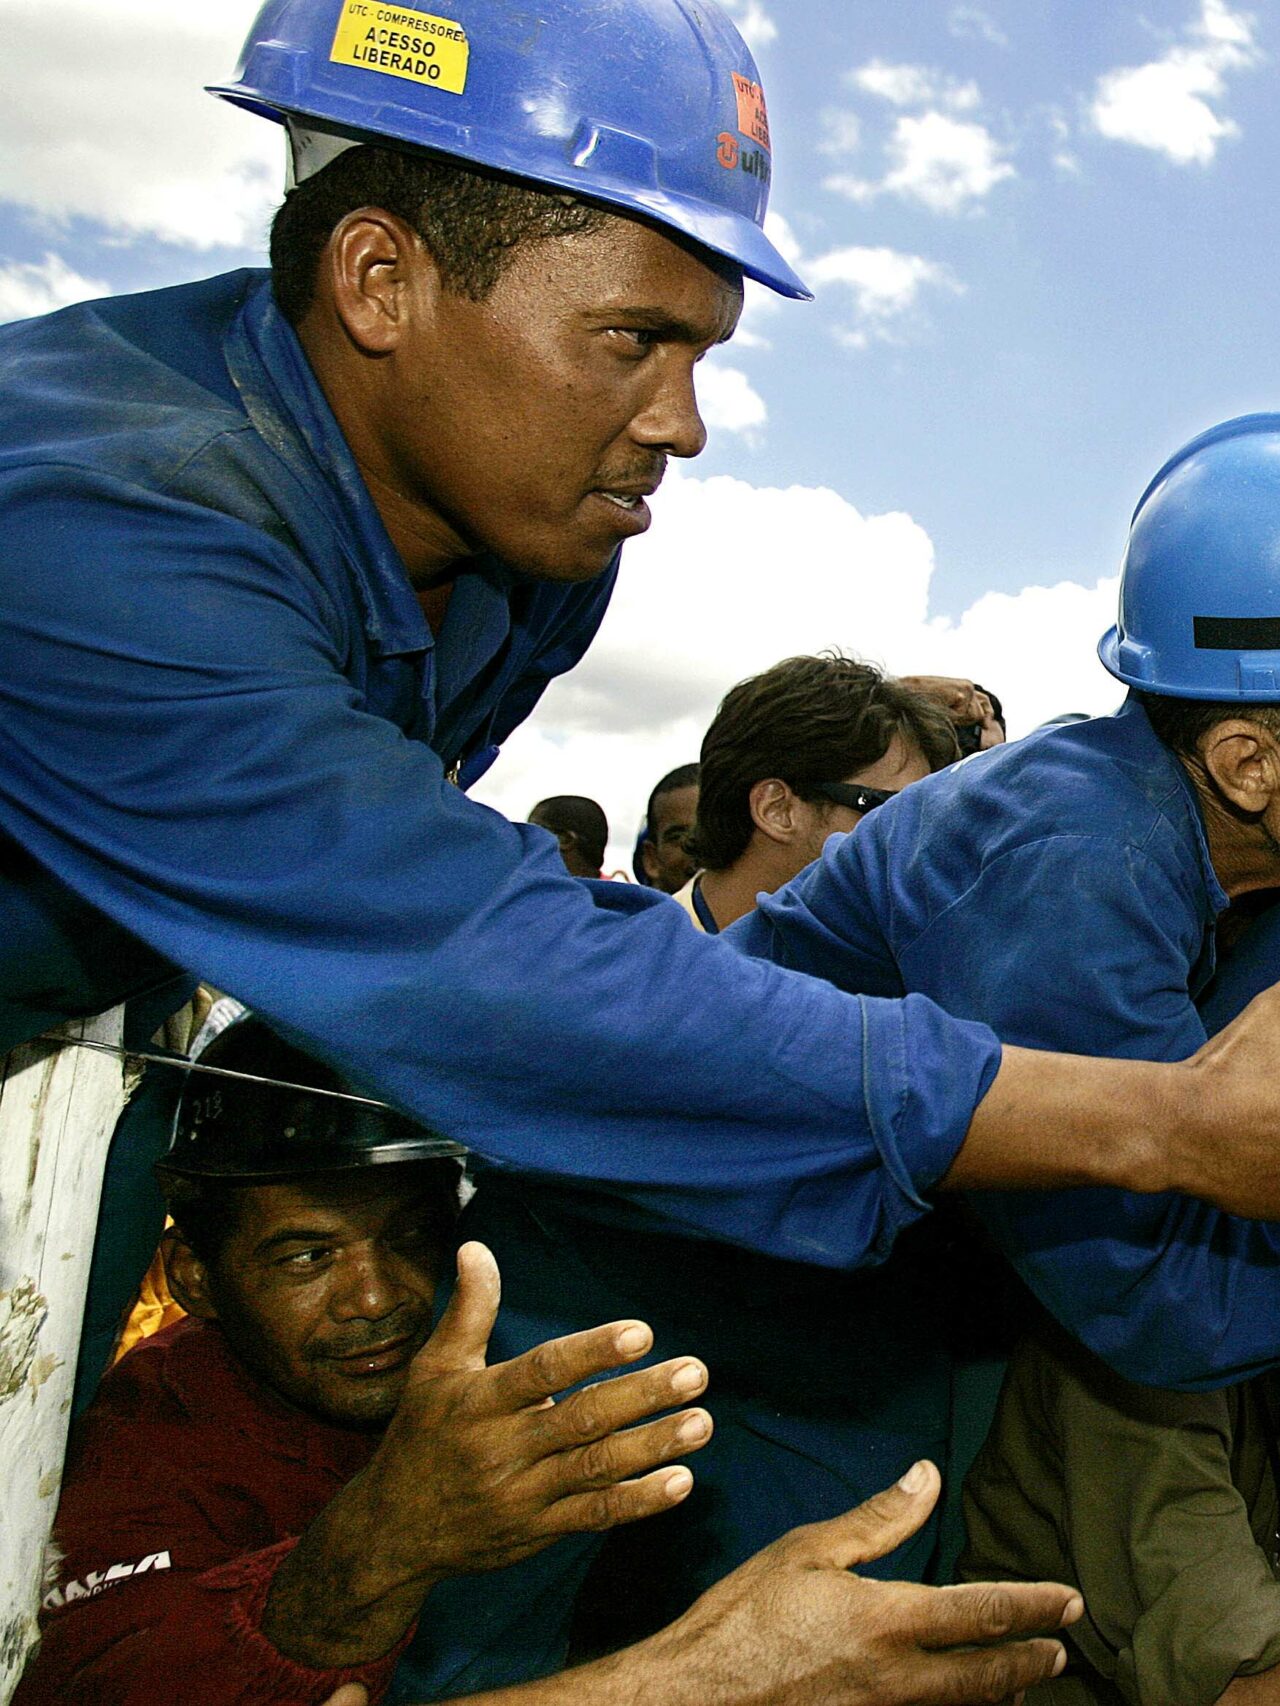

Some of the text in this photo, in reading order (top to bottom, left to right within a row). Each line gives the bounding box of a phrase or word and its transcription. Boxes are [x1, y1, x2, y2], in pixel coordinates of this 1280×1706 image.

[349, 4, 369, 16] UTC
[365, 27, 436, 57] ACESSO
[353, 44, 441, 80] LIBERADO
